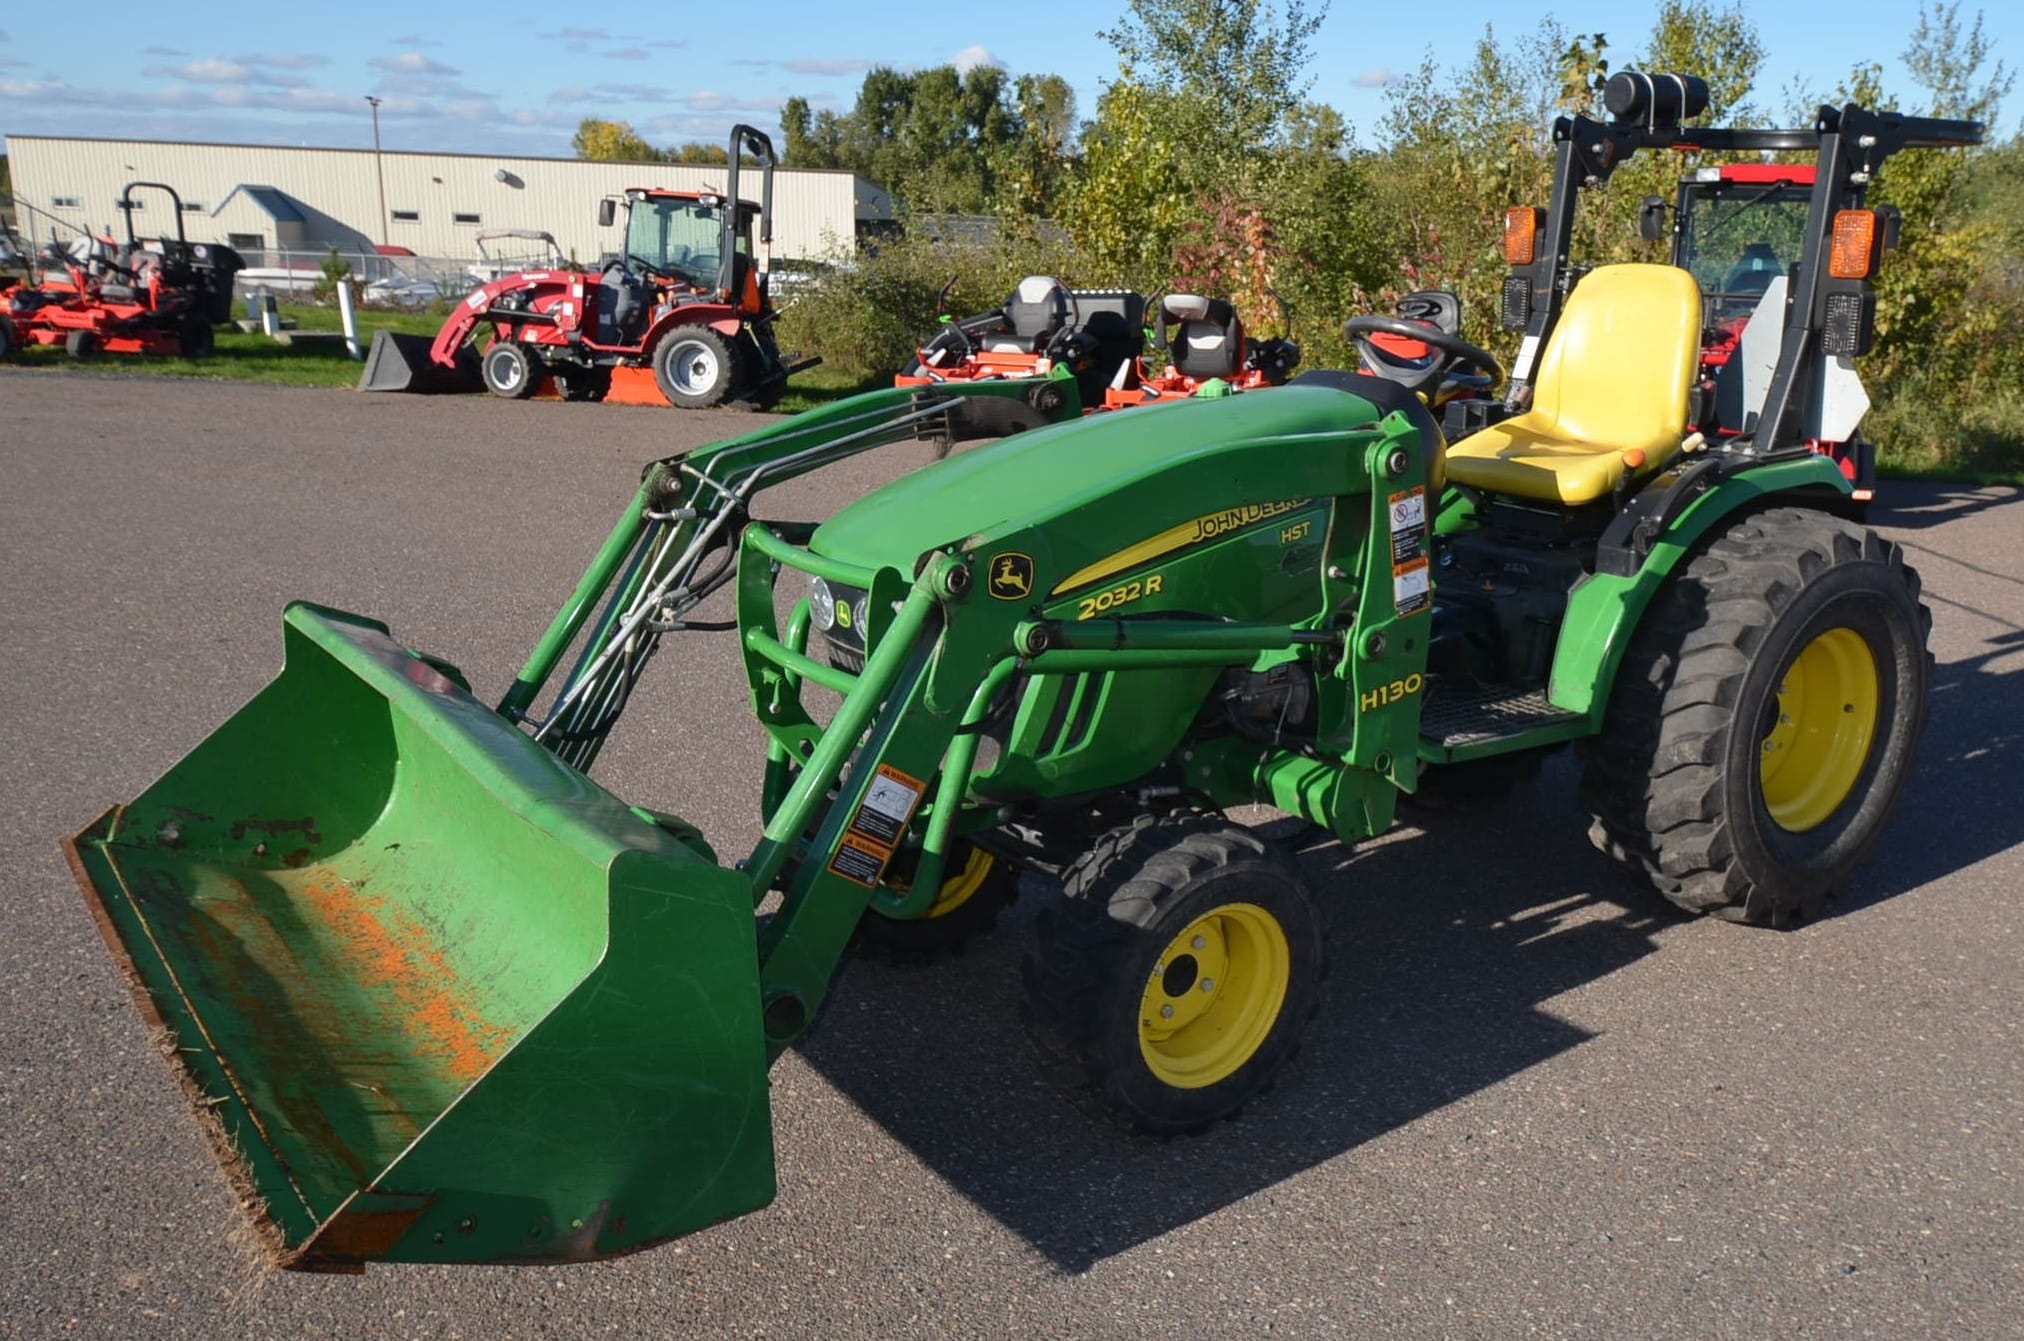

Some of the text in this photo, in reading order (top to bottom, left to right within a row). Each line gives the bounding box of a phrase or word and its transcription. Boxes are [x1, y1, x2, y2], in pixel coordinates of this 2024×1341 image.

[1192, 507, 1244, 542] JOHN
[1281, 520, 1311, 544] HST
[1078, 575, 1162, 621] 2032 R
[1361, 673, 1421, 713] H130
